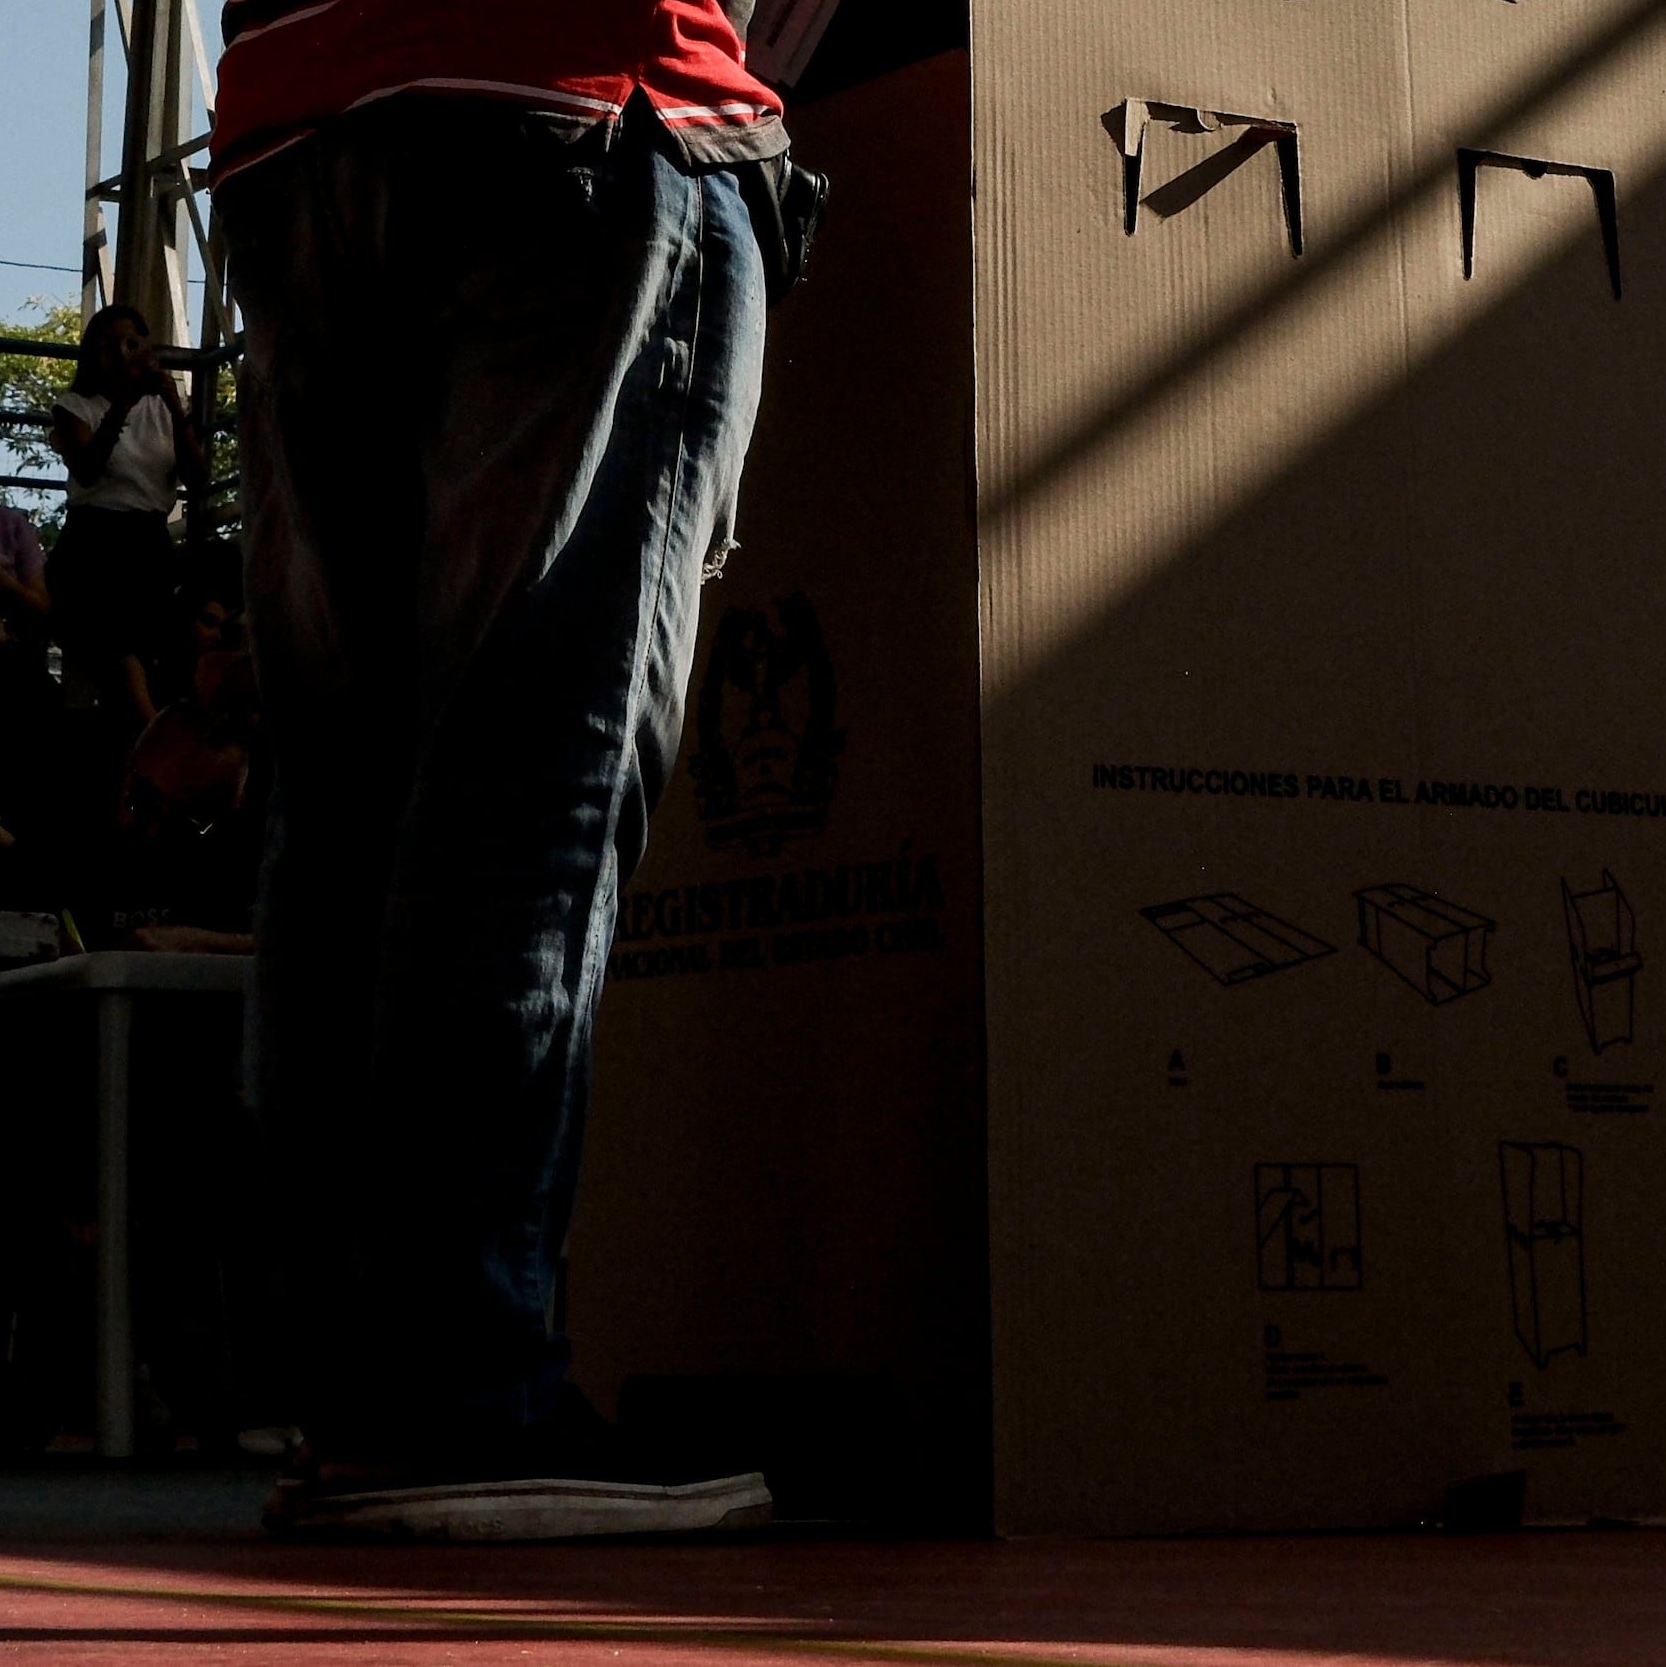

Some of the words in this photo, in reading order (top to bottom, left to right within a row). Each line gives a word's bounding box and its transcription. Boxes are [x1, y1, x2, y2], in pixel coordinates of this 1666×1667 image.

[1092, 764, 1299, 799] INSTRUCCIONES
[1306, 775, 1374, 802] PARA
[1378, 778, 1410, 804] EL
[1414, 781, 1519, 809] ARMADO
[1524, 787, 1571, 813] DEL
[1168, 1049, 1186, 1071] A
[1553, 1056, 1568, 1078] C
